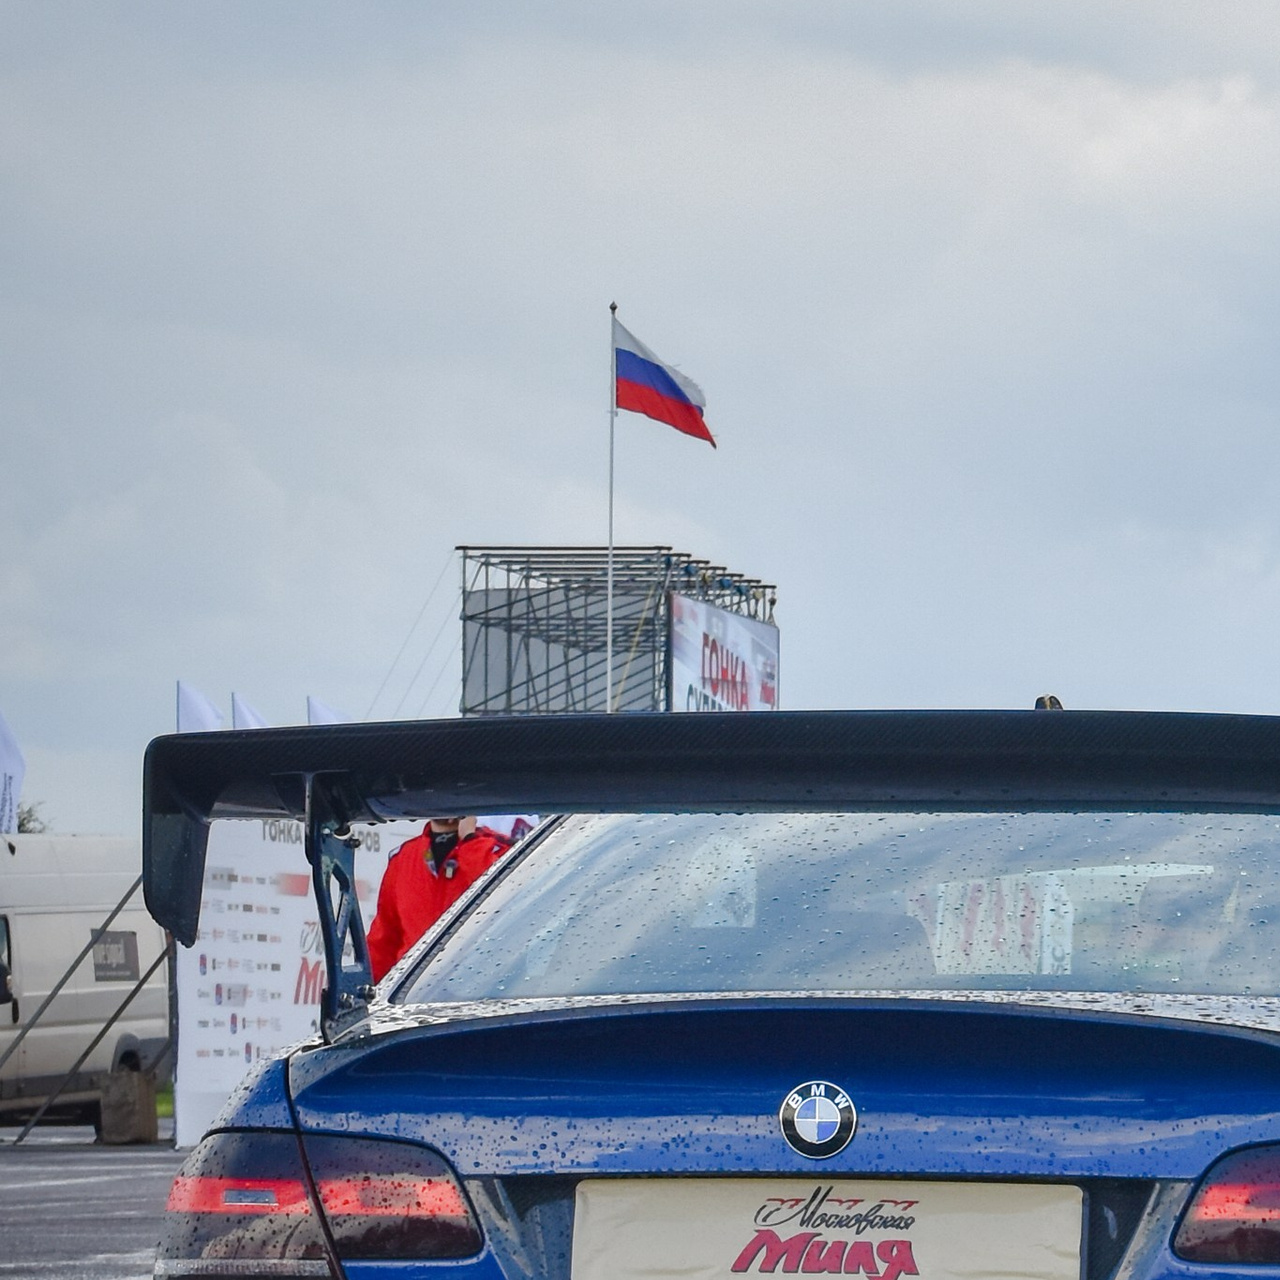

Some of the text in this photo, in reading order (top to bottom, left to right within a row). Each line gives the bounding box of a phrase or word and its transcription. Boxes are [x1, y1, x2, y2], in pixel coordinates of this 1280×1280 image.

[702, 631, 749, 711] ГОНКА
[262, 821, 303, 845] ГОНКА
[788, 1084, 850, 1109] BMW
[754, 1186, 916, 1235] Московская
